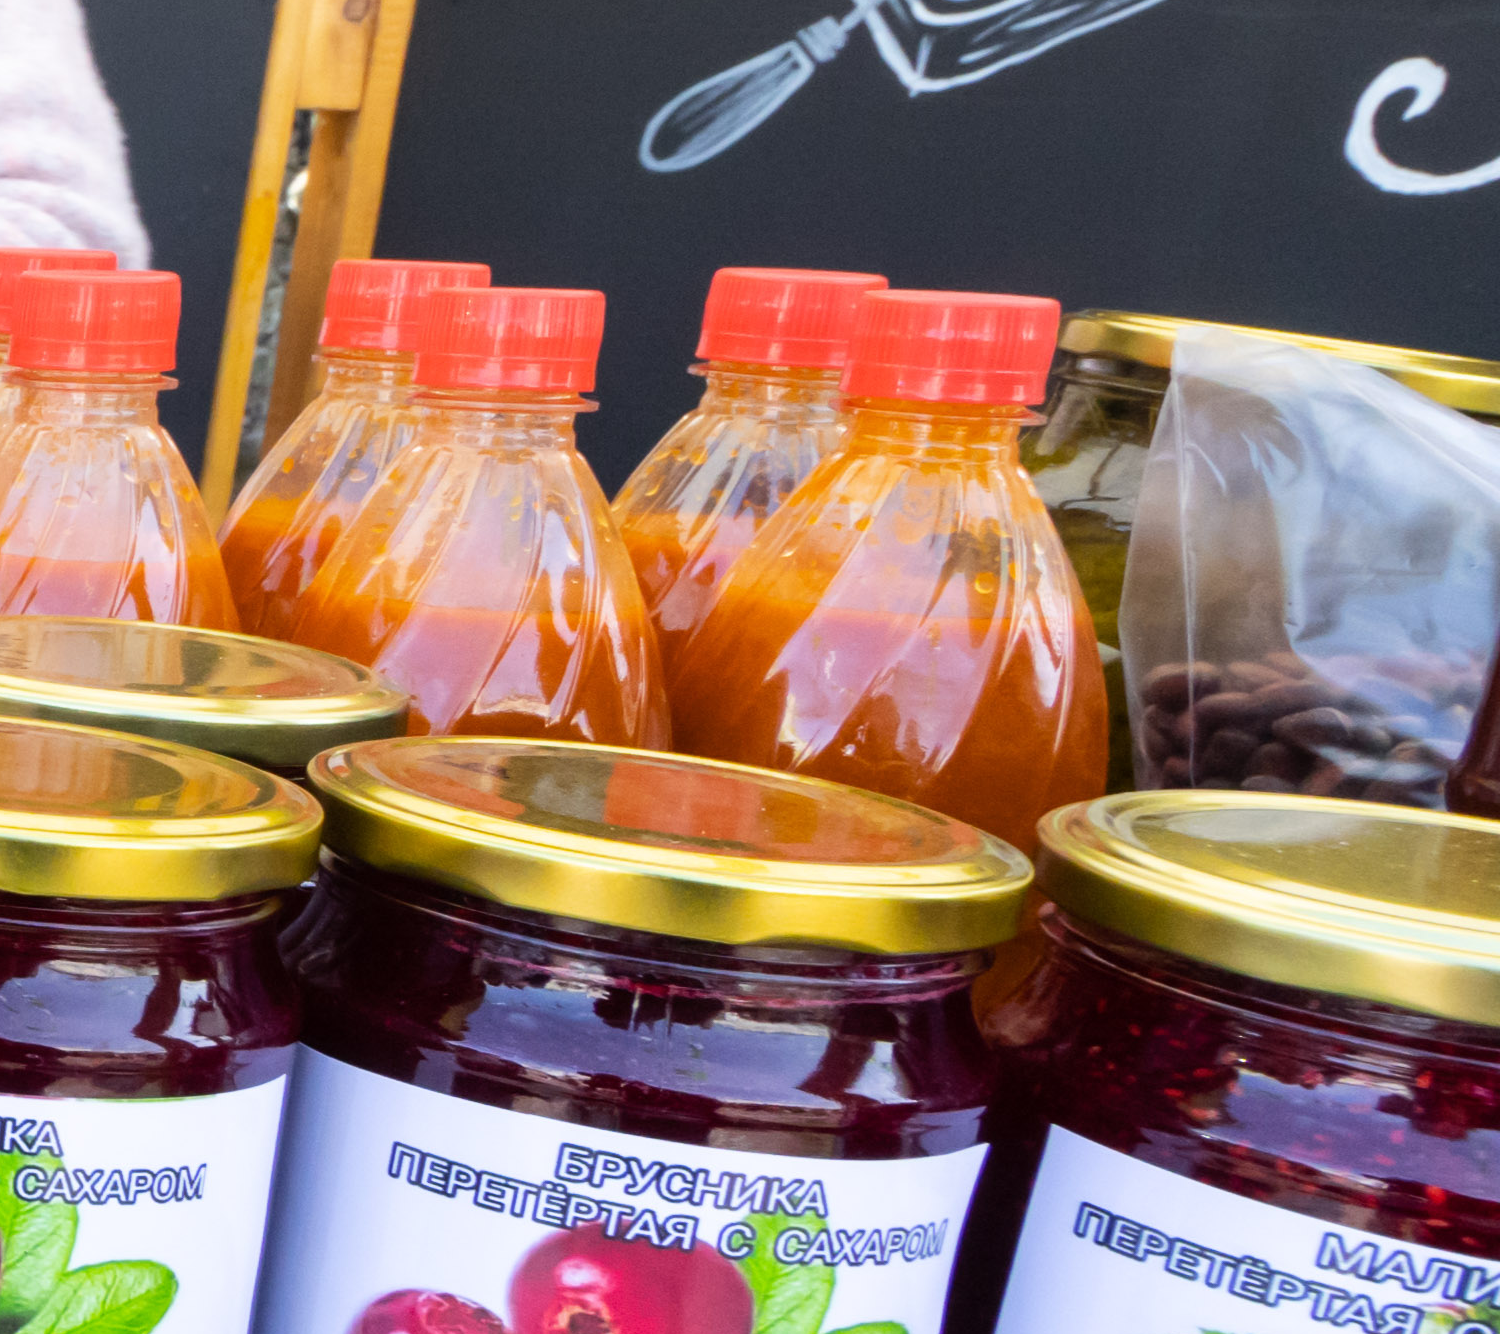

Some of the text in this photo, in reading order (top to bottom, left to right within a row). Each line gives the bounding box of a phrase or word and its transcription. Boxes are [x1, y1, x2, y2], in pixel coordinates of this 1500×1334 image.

[12, 1162, 209, 1206] САХАРОМ
[387, 1140, 948, 1269] ПЕРЕТЁРТАЯ С САХАРОМ
[554, 1142, 828, 1219] БРУСНИКА
